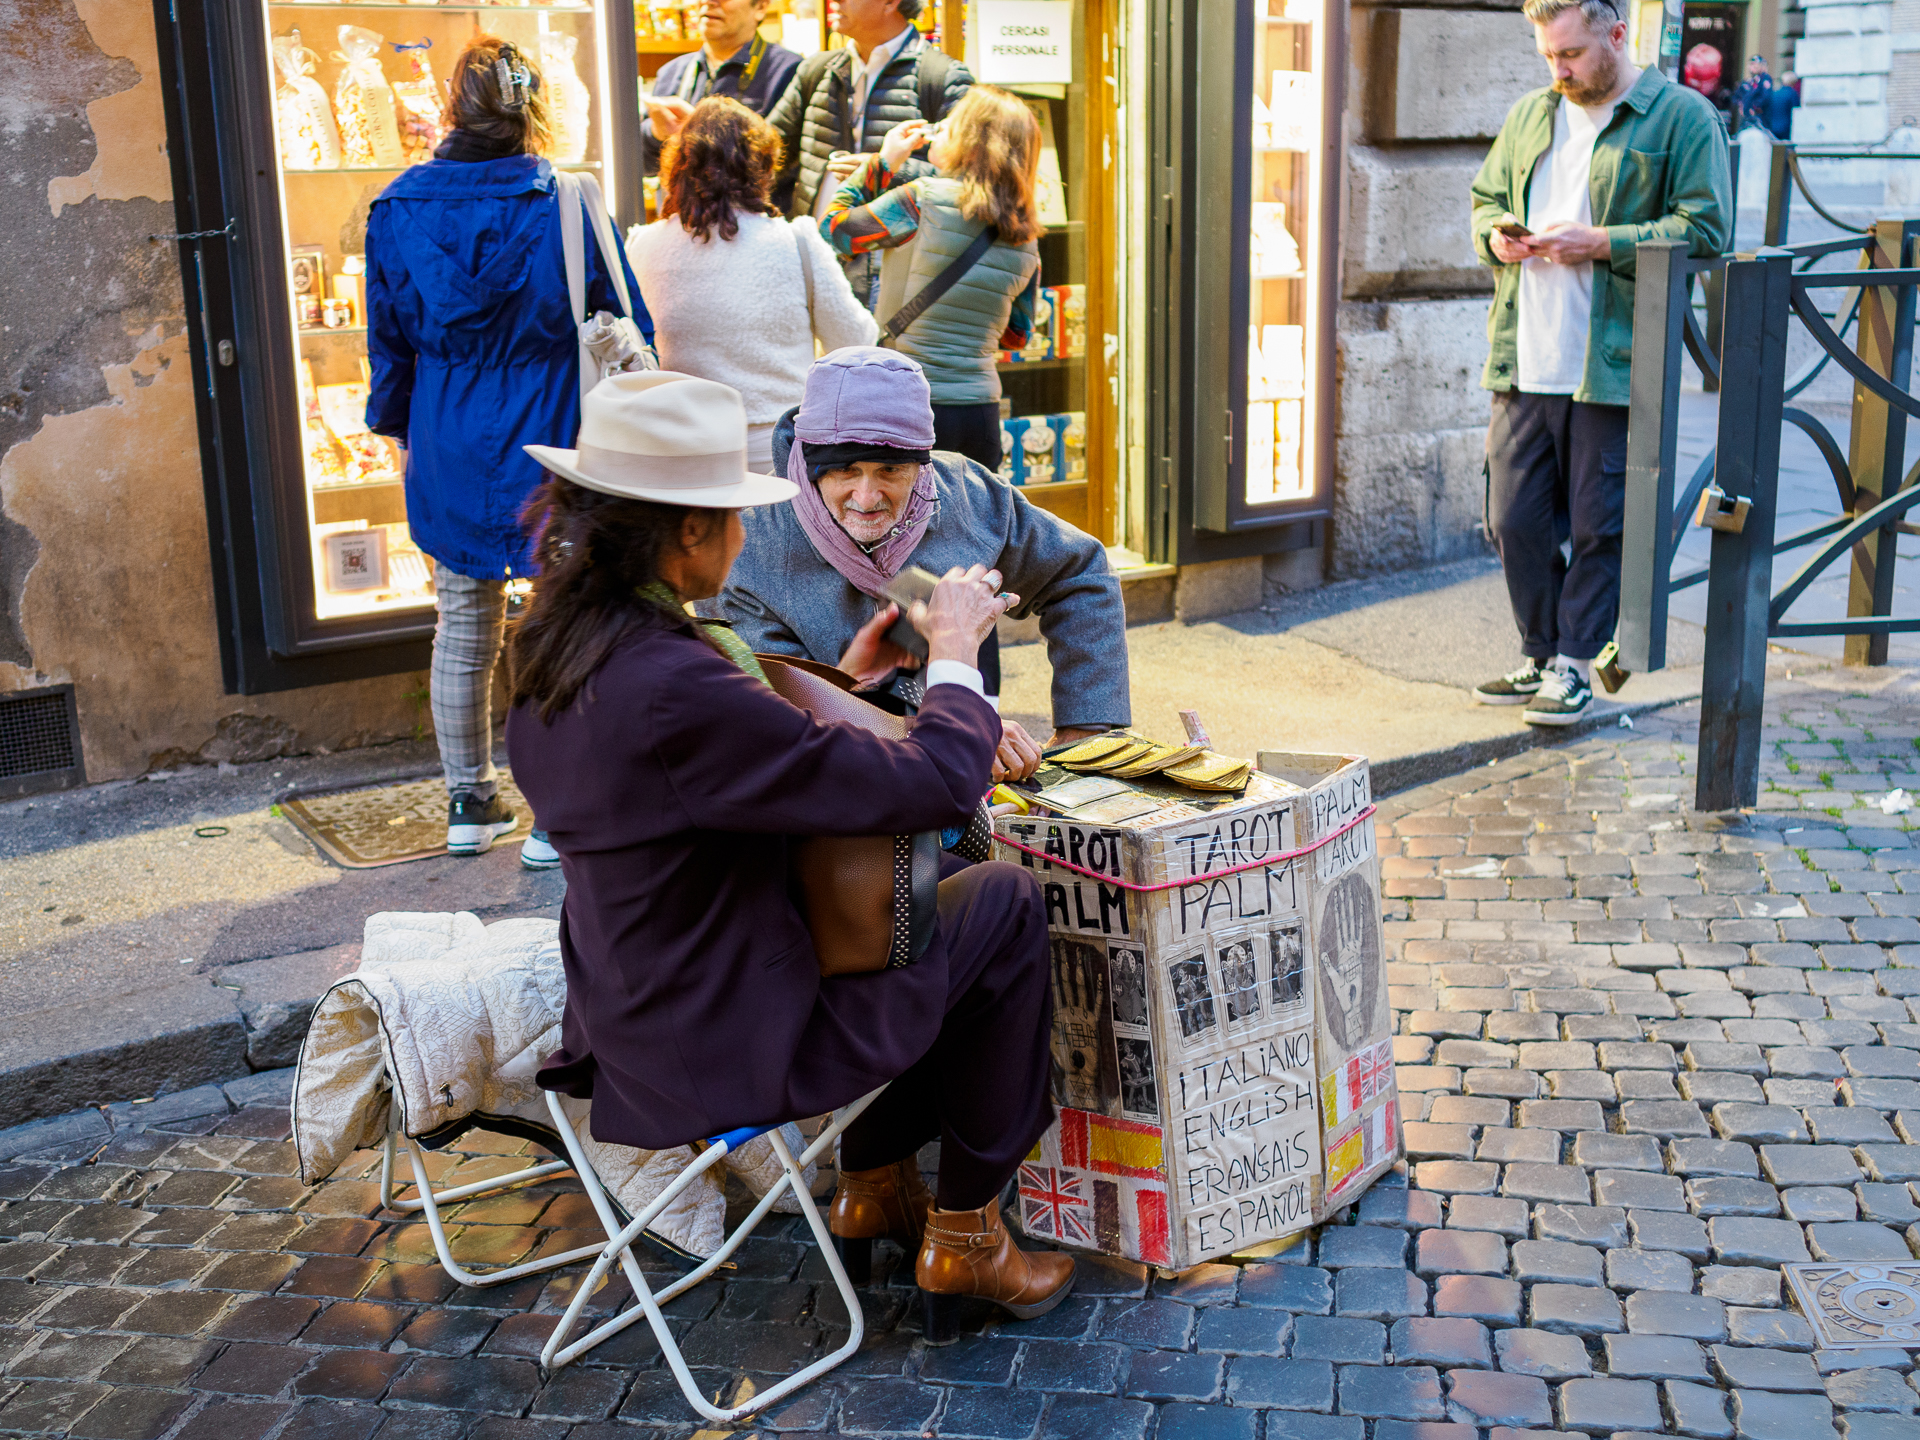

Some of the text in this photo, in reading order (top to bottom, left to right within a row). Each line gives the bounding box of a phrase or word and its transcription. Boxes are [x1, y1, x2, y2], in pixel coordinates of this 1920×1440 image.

[992, 44, 1059, 56] PERSONALE
[1000, 25, 1050, 37] CERCASI
[1315, 774, 1367, 834] PALM
[1008, 823, 1122, 879] TAROT
[1175, 807, 1290, 876] TAROT
[1040, 881, 1130, 935] ALM
[1179, 858, 1297, 935] PALM
[1198, 1181, 1310, 1252] ESPAÑOL
